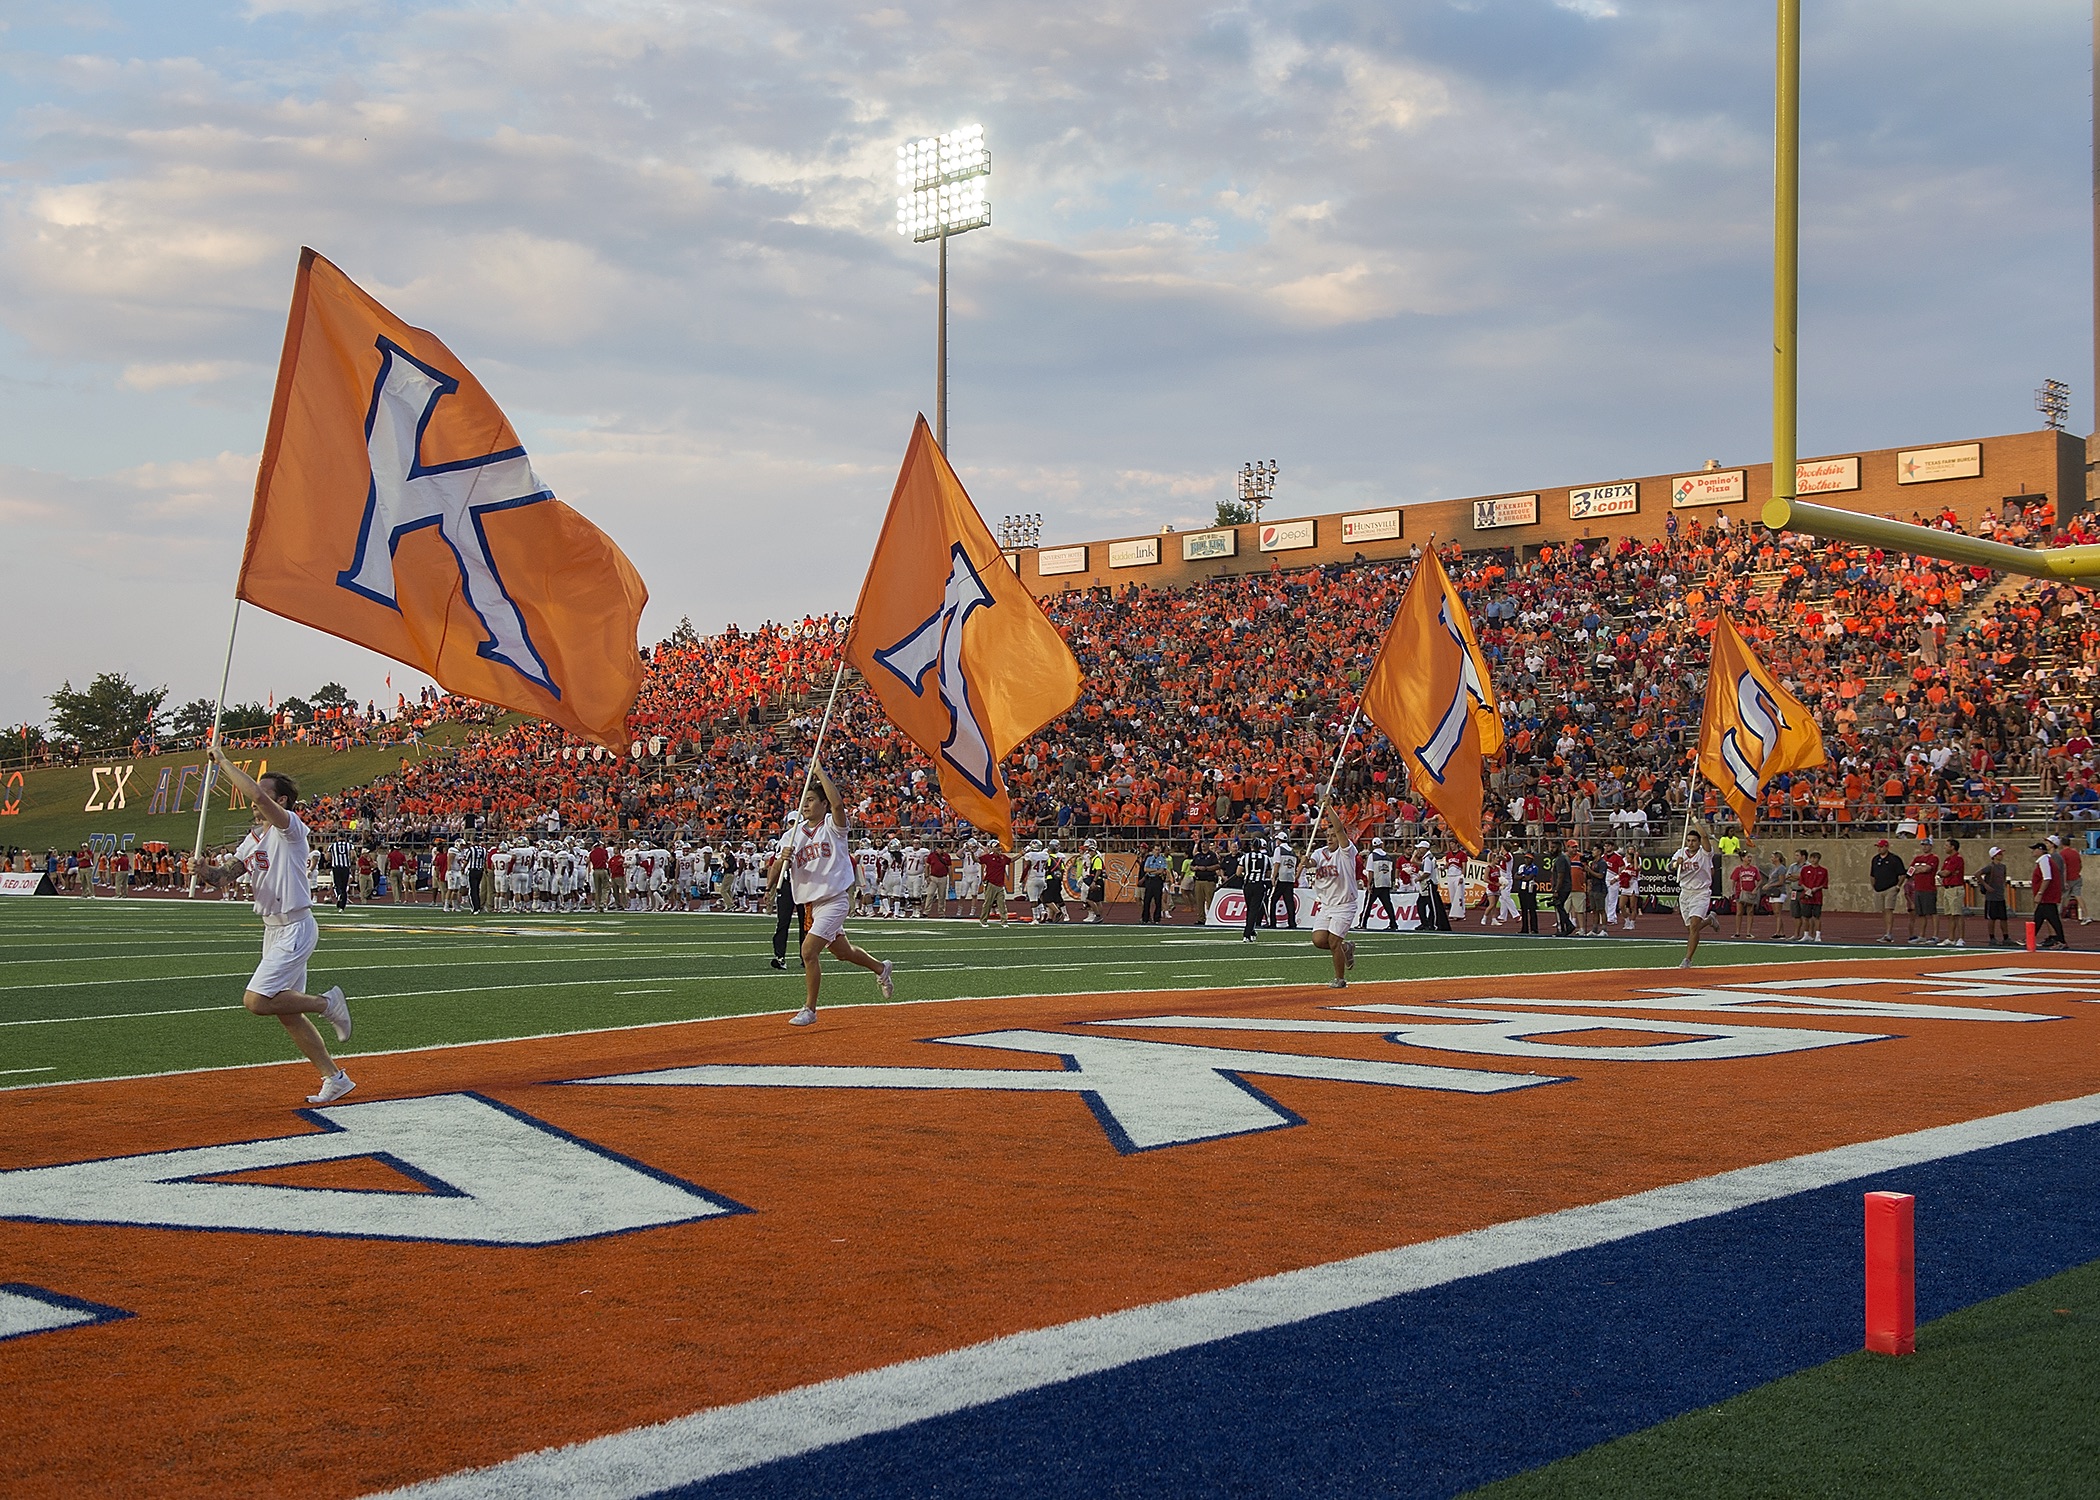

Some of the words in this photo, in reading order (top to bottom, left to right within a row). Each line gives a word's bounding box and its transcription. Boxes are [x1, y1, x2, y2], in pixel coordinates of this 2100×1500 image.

[1796, 465, 1845, 479] Brookshire
[1697, 476, 1739, 486] Domino's
[1798, 479, 1842, 492] Brothers
[1594, 485, 1633, 499] KBTX
[336, 332, 556, 700] K
[1280, 528, 1310, 541] pepsi
[1111, 544, 1155, 561] suddenlink
[794, 841, 832, 869] KATS
[862, 854, 876, 865] 92
[494, 860, 506, 871] 13
[908, 857, 920, 871] 71
[1250, 858, 1262, 872] L
[2, 879, 20, 889] RED
